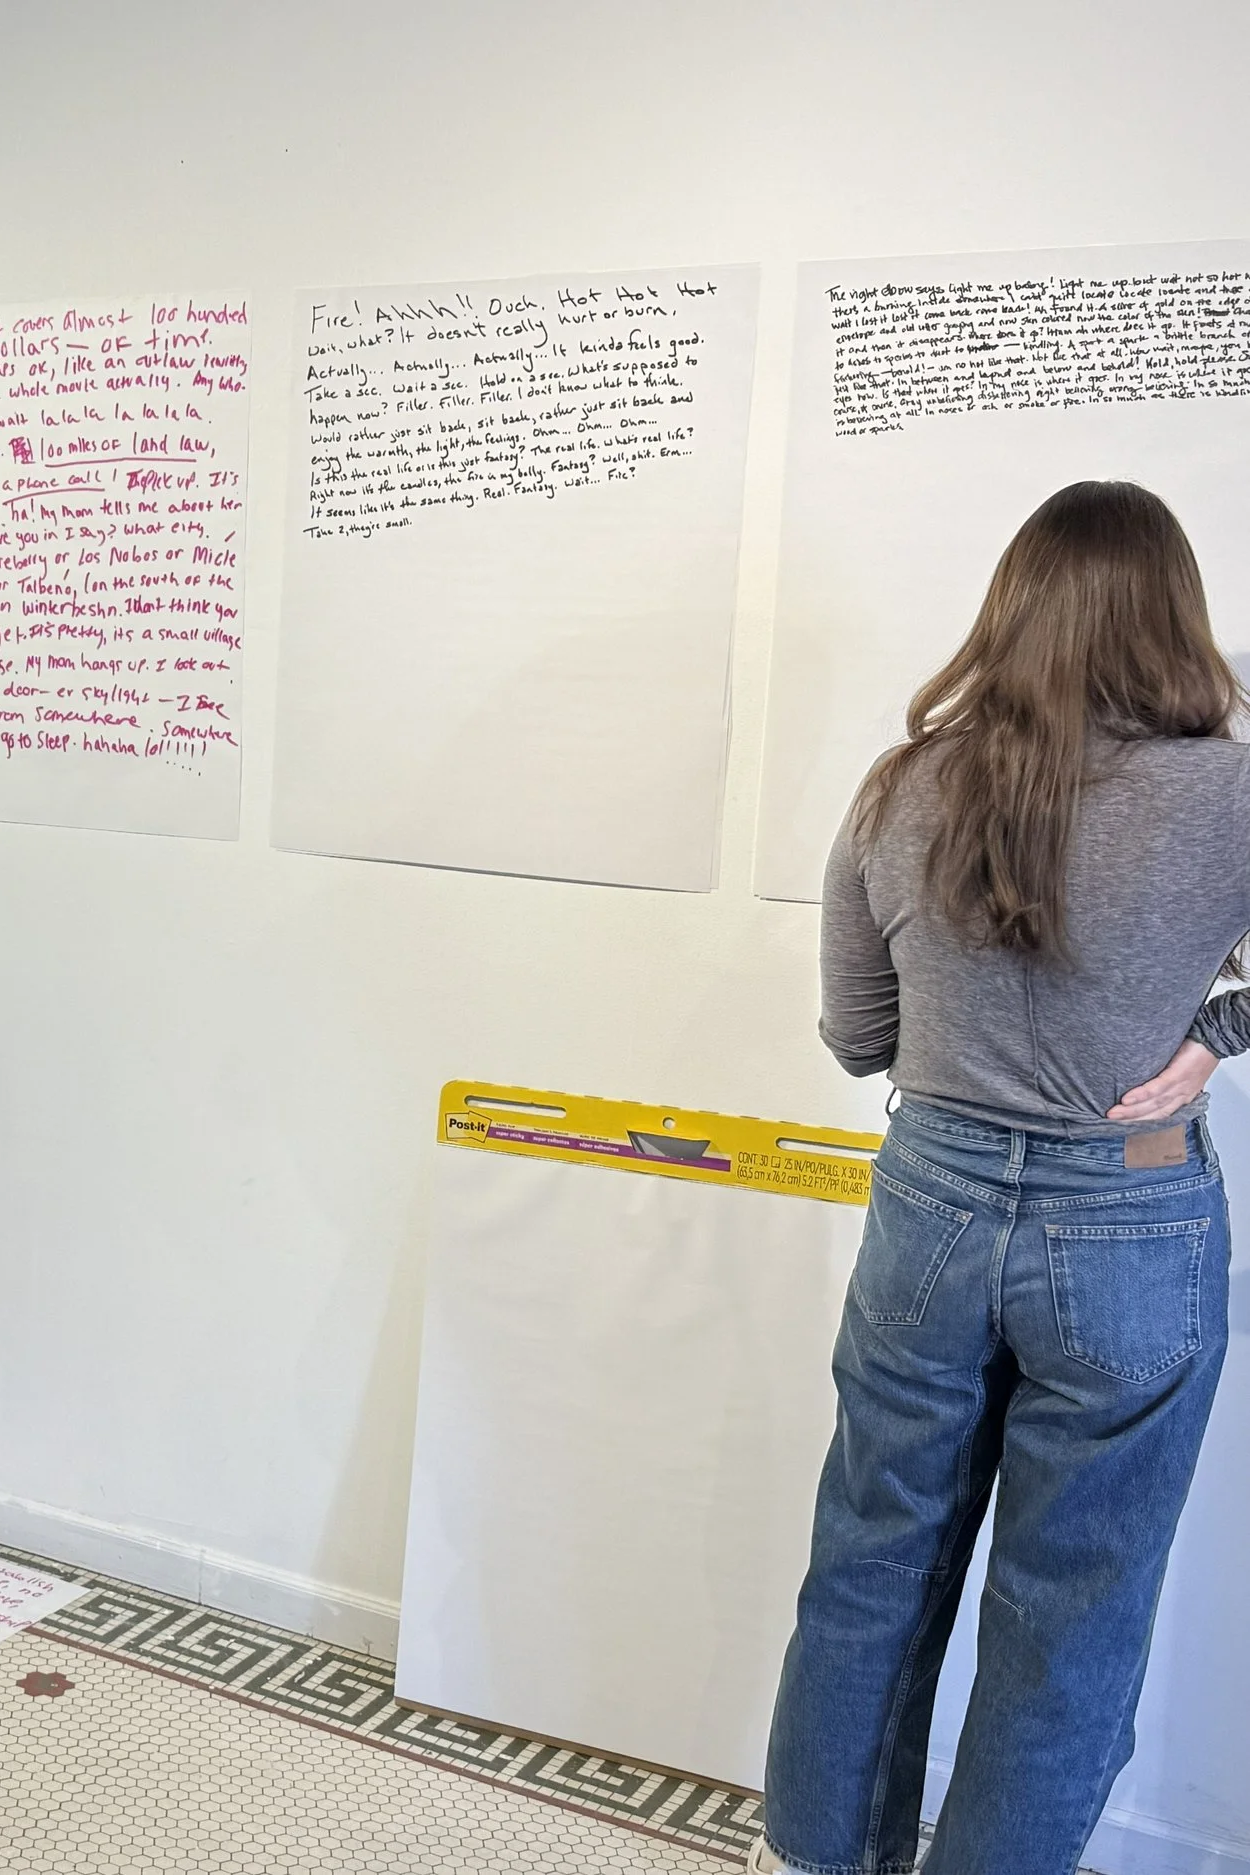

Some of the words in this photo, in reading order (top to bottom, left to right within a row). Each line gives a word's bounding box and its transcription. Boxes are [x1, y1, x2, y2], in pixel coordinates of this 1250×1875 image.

[12, 314, 54, 334] covers
[186, 300, 247, 325] hundred
[311, 300, 362, 334] Fire!
[376, 294, 478, 323] Ahhh!!
[488, 295, 545, 316] Ouch.
[558, 288, 602, 307] Hot
[616, 286, 658, 302] Hot
[677, 282, 717, 296] Hot
[347, 329, 394, 349] what?
[400, 326, 414, 343] It
[427, 322, 486, 340] doesn't
[496, 319, 548, 348] really
[558, 311, 597, 325] hurt
[604, 309, 618, 319] or
[64, 356, 96, 376] like
[104, 356, 126, 369] an
[135, 353, 195, 369] outlaw
[307, 364, 384, 386] Actually...
[394, 358, 465, 378] Actually...
[473, 348, 548, 373] Actually...
[553, 344, 566, 356] It
[580, 336, 623, 354] kinda
[628, 328, 660, 351] feels
[669, 332, 704, 357] good.
[9, 381, 48, 399] whole
[56, 375, 98, 392] movie
[304, 385, 338, 403] Take
[356, 387, 381, 397] sec.
[431, 382, 437, 390] a
[442, 381, 468, 390] sec.
[480, 373, 506, 388] Hold
[530, 374, 536, 382] a
[613, 358, 678, 376] supposed
[685, 355, 697, 366] to
[310, 409, 352, 428] happen
[357, 402, 388, 421] now?
[397, 399, 433, 412] Filler.
[439, 396, 474, 409] Filler.
[480, 391, 512, 405] Filler.
[518, 387, 522, 399] I
[527, 385, 552, 397] don't
[559, 381, 587, 394] know
[593, 377, 622, 390] what
[628, 377, 638, 387] to
[644, 373, 683, 387] think.
[134, 432, 168, 454] land
[62, 500, 93, 519] mom
[100, 496, 130, 514] tells
[138, 500, 158, 513] me
[168, 495, 213, 513] about
[303, 527, 333, 539] Take
[386, 518, 412, 528] small.
[168, 599, 210, 614] think
[141, 630, 153, 640] a
[159, 628, 198, 642] small
[204, 625, 241, 651] village
[754, 1171, 764, 1180] cm
[760, 1155, 768, 1166] 30
[784, 1158, 792, 1169] 25
[849, 1167, 857, 1179] 30
